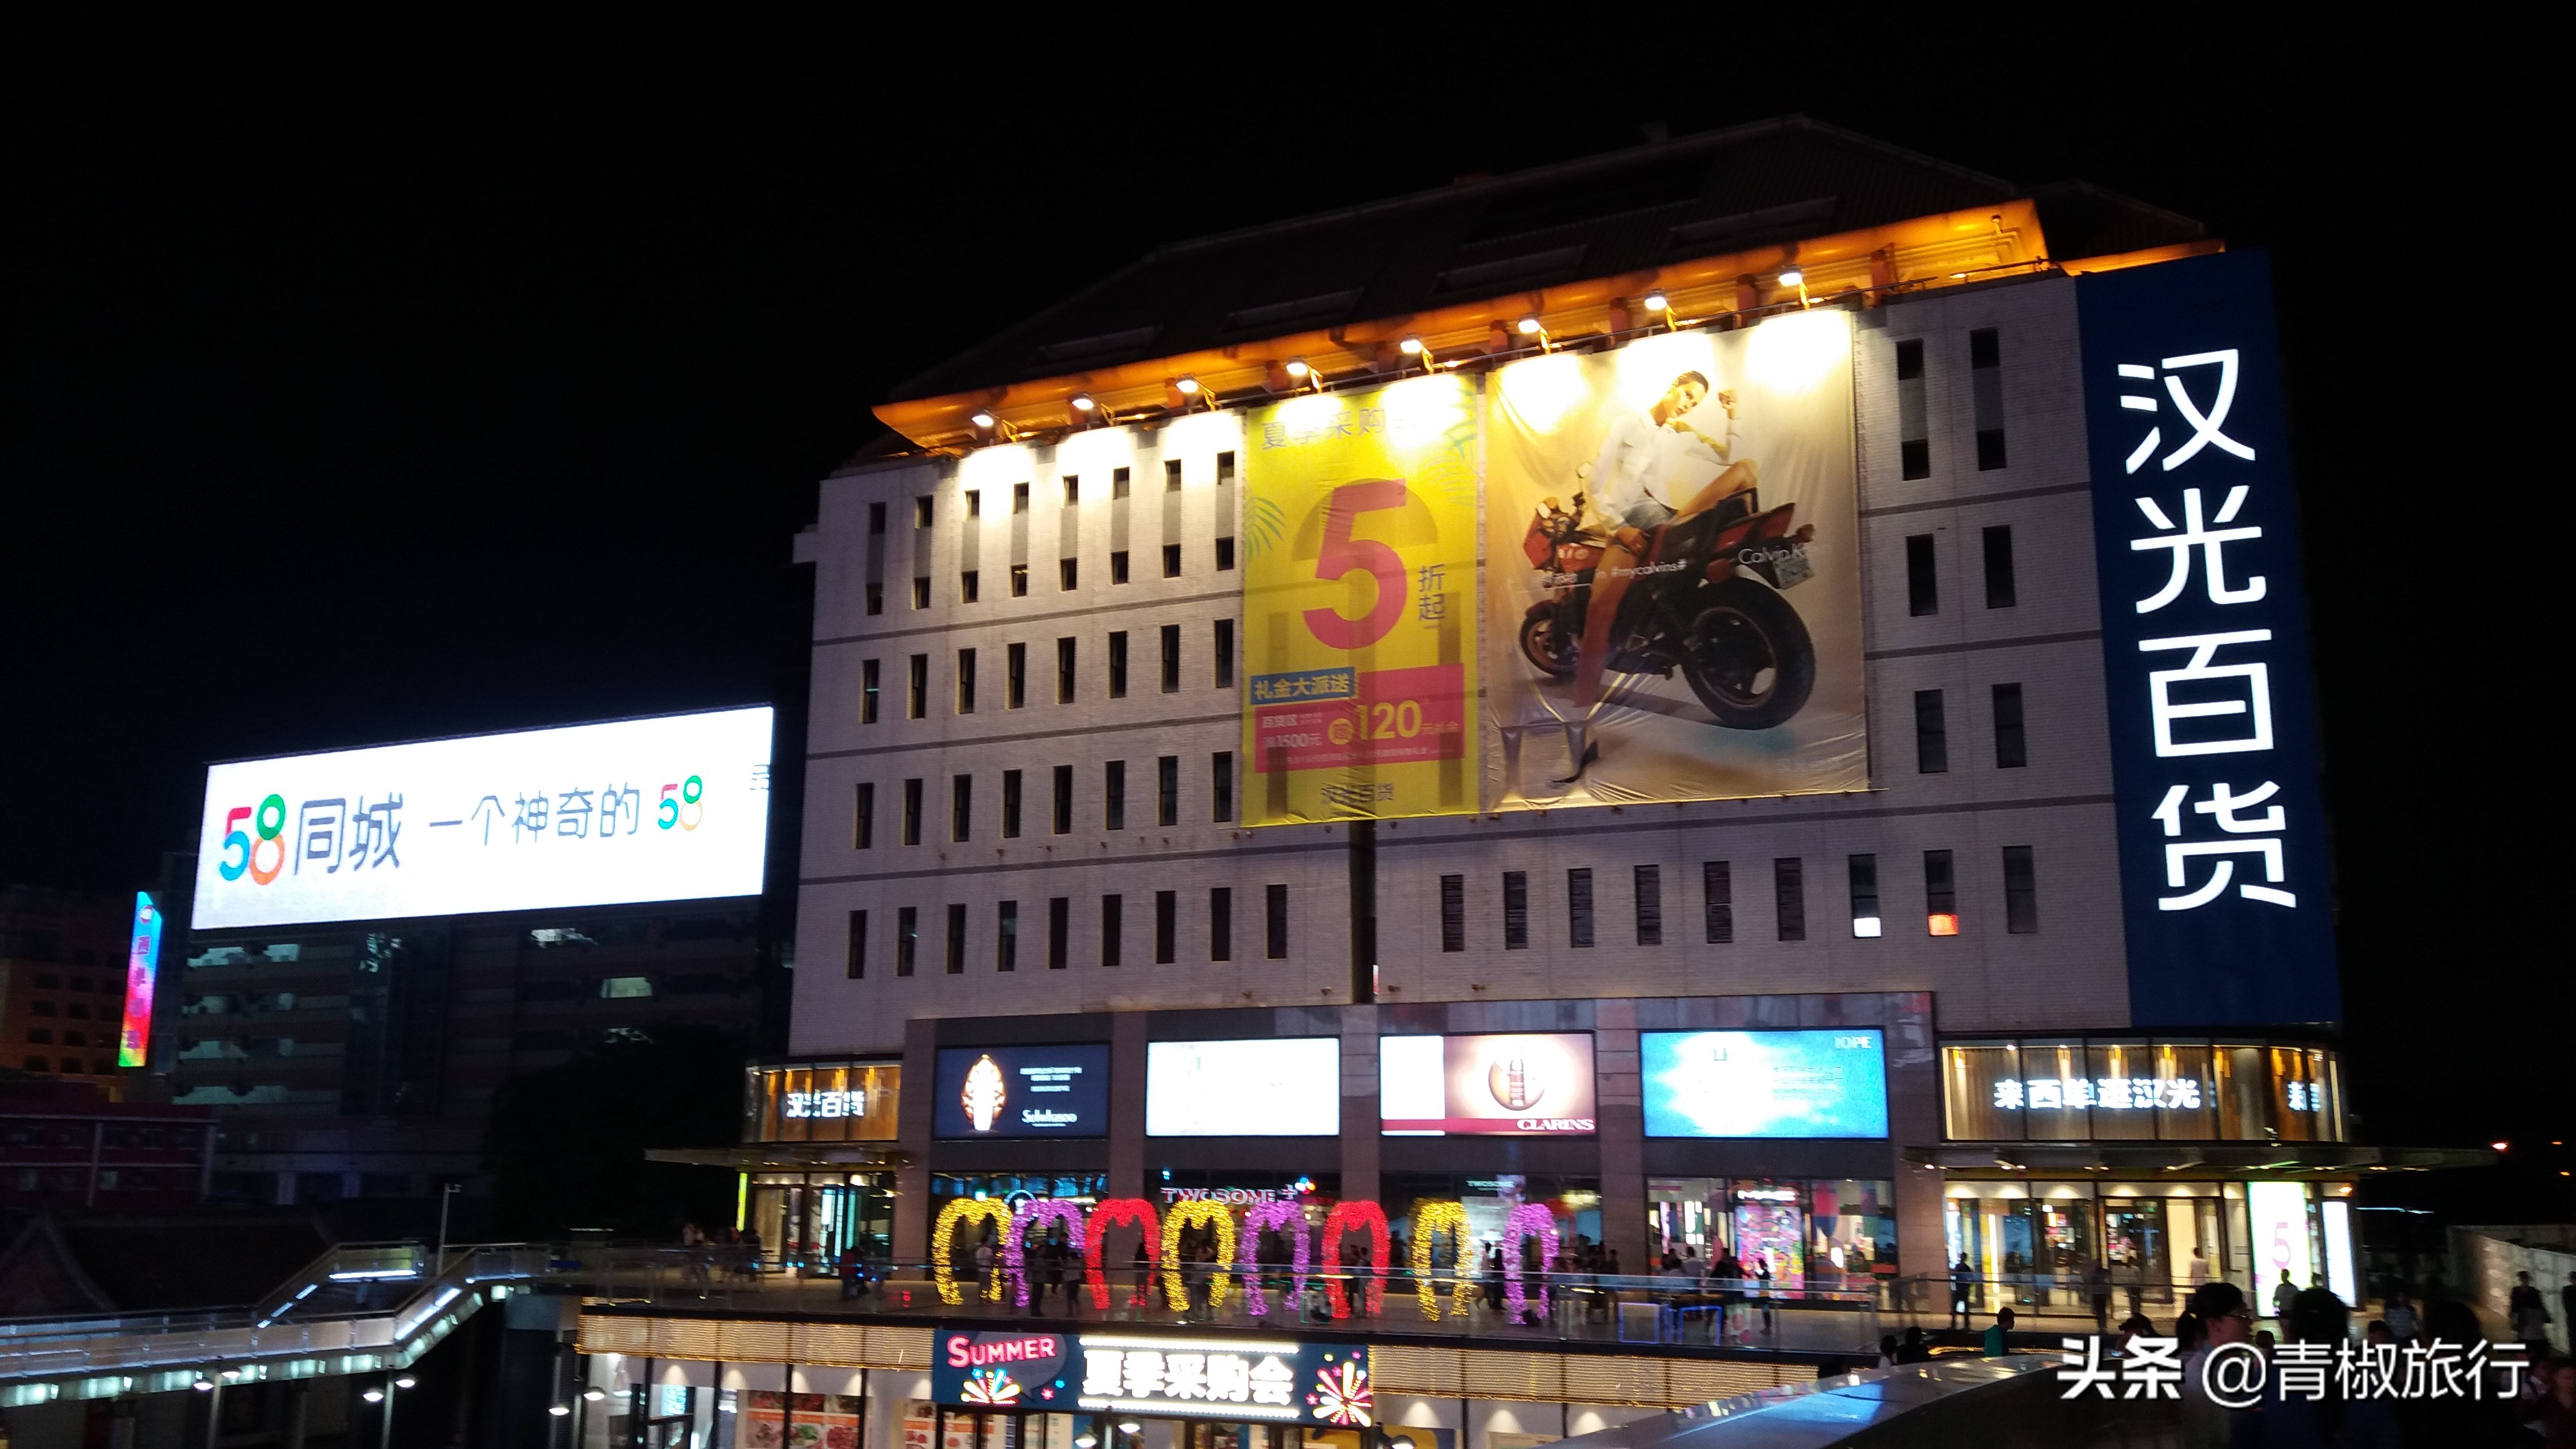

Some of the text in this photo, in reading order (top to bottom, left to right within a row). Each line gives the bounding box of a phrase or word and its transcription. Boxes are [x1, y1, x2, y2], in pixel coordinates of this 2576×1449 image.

[1302, 479, 1407, 650] 5
[1418, 564, 1445, 620] 折起
[2117, 348, 2296, 911] 汉光百货
[1255, 673, 1351, 700] 礼金大派送
[1355, 700, 1422, 740] 120
[1994, 1078, 2201, 1110] 来西单逛汉光
[1517, 1119, 1594, 1130] CLARINS
[1082, 1350, 1294, 1405] 夏季采购会
